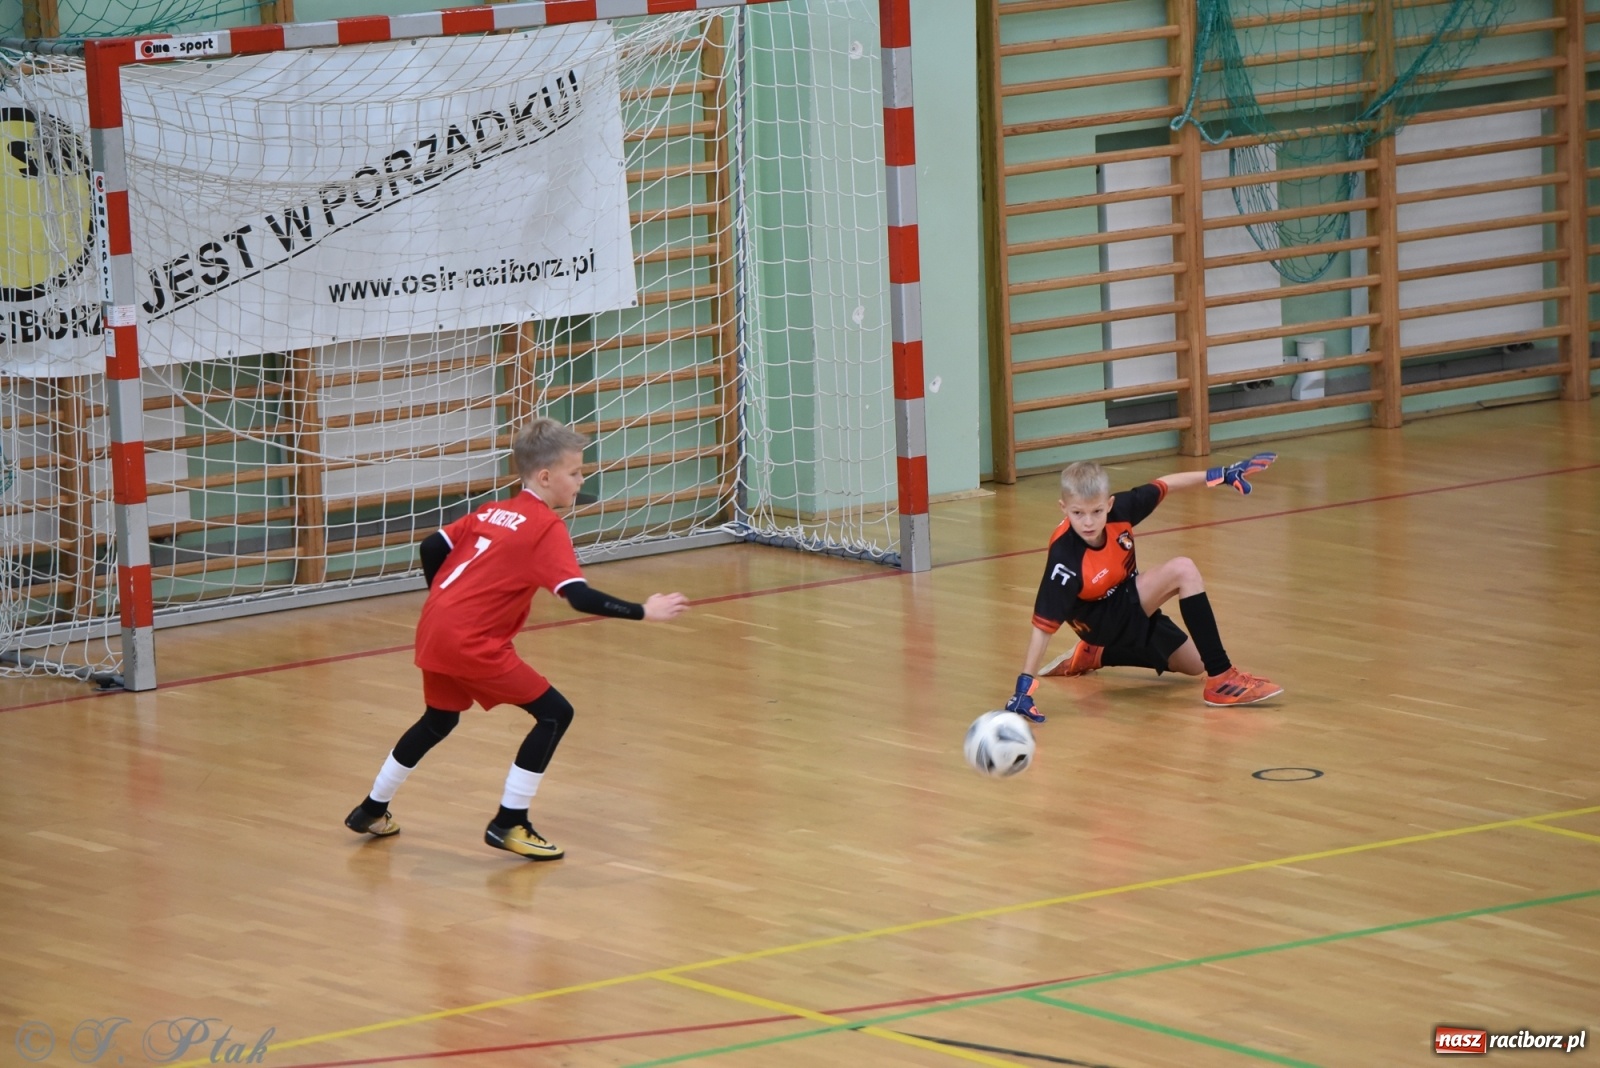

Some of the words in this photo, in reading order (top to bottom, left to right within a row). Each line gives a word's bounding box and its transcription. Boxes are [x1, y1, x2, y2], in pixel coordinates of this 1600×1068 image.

[179, 37, 214, 54] sport
[101, 239, 110, 299] sport
[142, 224, 254, 314] JEST
[264, 200, 313, 252] W
[328, 247, 598, 303] www.osir-raciborz.pl
